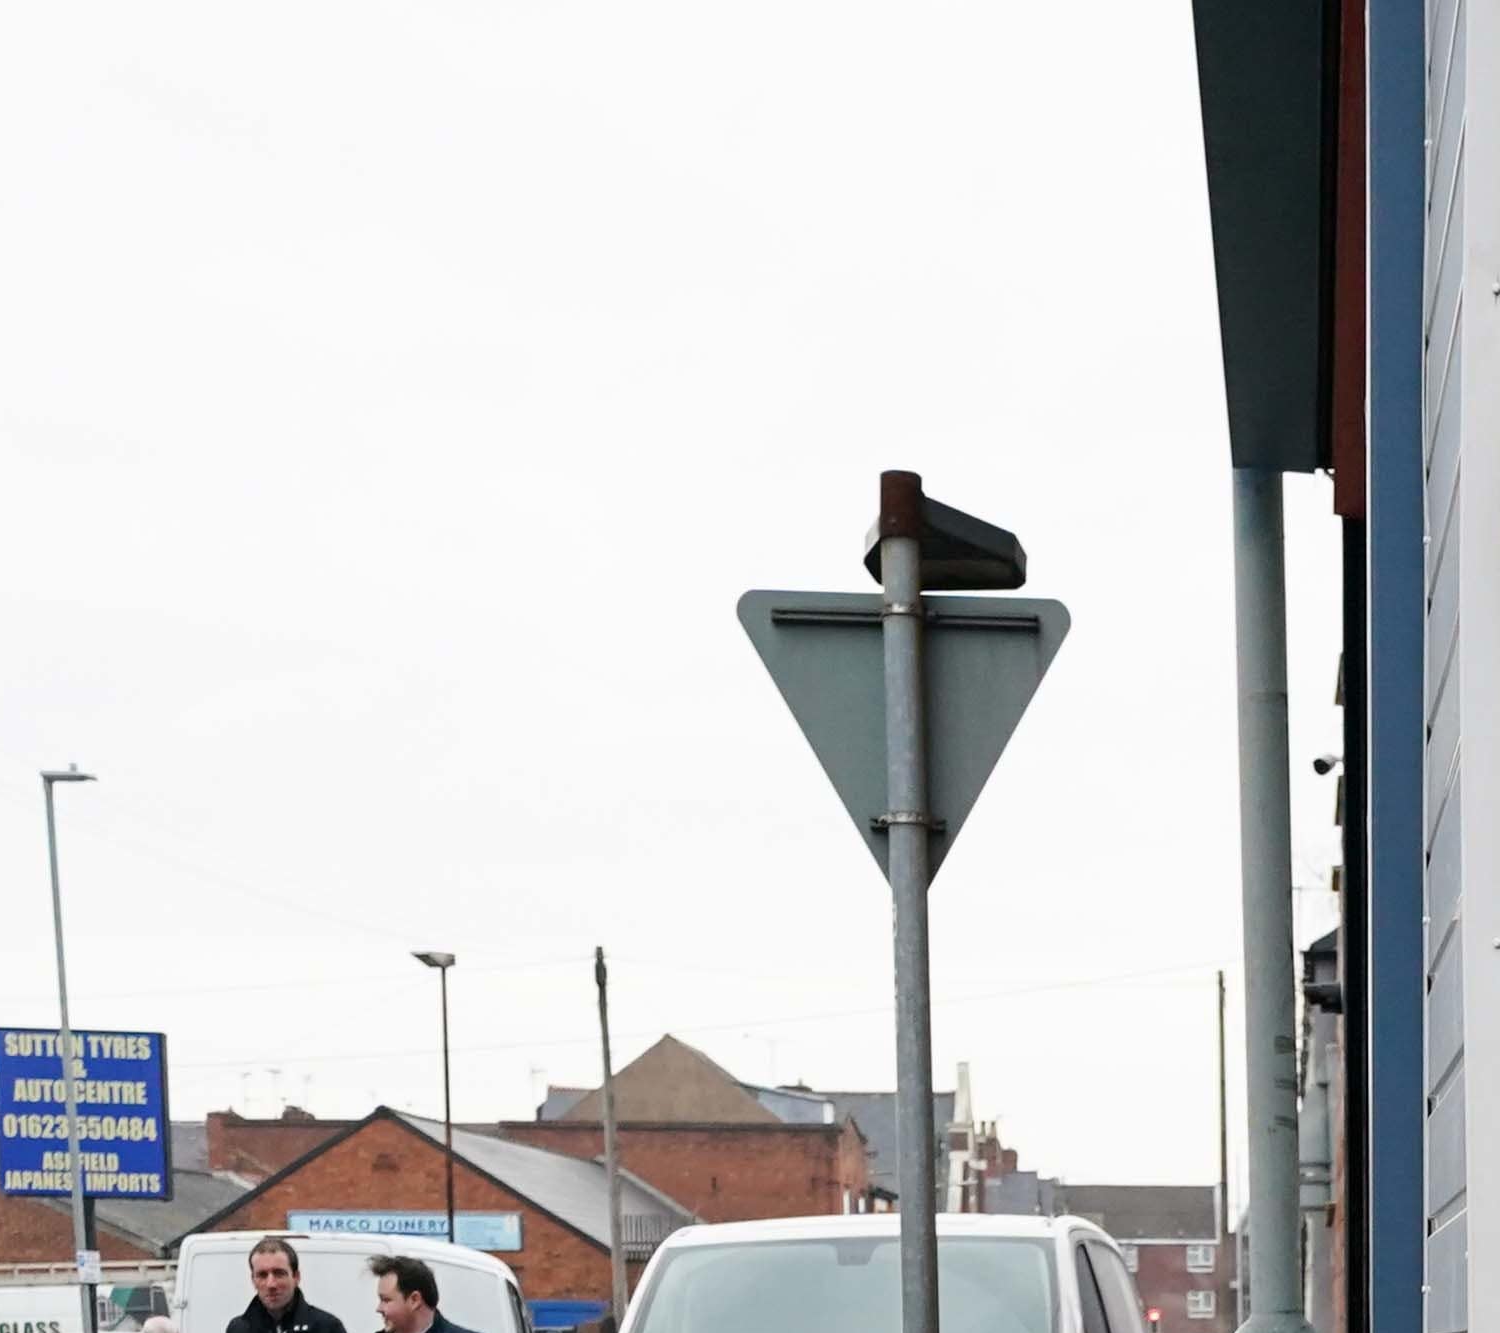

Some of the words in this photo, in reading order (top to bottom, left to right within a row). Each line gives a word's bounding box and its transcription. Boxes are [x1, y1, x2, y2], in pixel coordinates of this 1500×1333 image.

[88, 1035, 152, 1060] TYRES
[13, 1078, 67, 1102] AUTO
[73, 1079, 148, 1105] CENTRE
[2, 1113, 70, 1139] 01623
[75, 1115, 158, 1141] 550484
[86, 1173, 161, 1193] IMPORTS
[309, 1218, 370, 1231] MARCO
[378, 1219, 447, 1232] JOINERY
